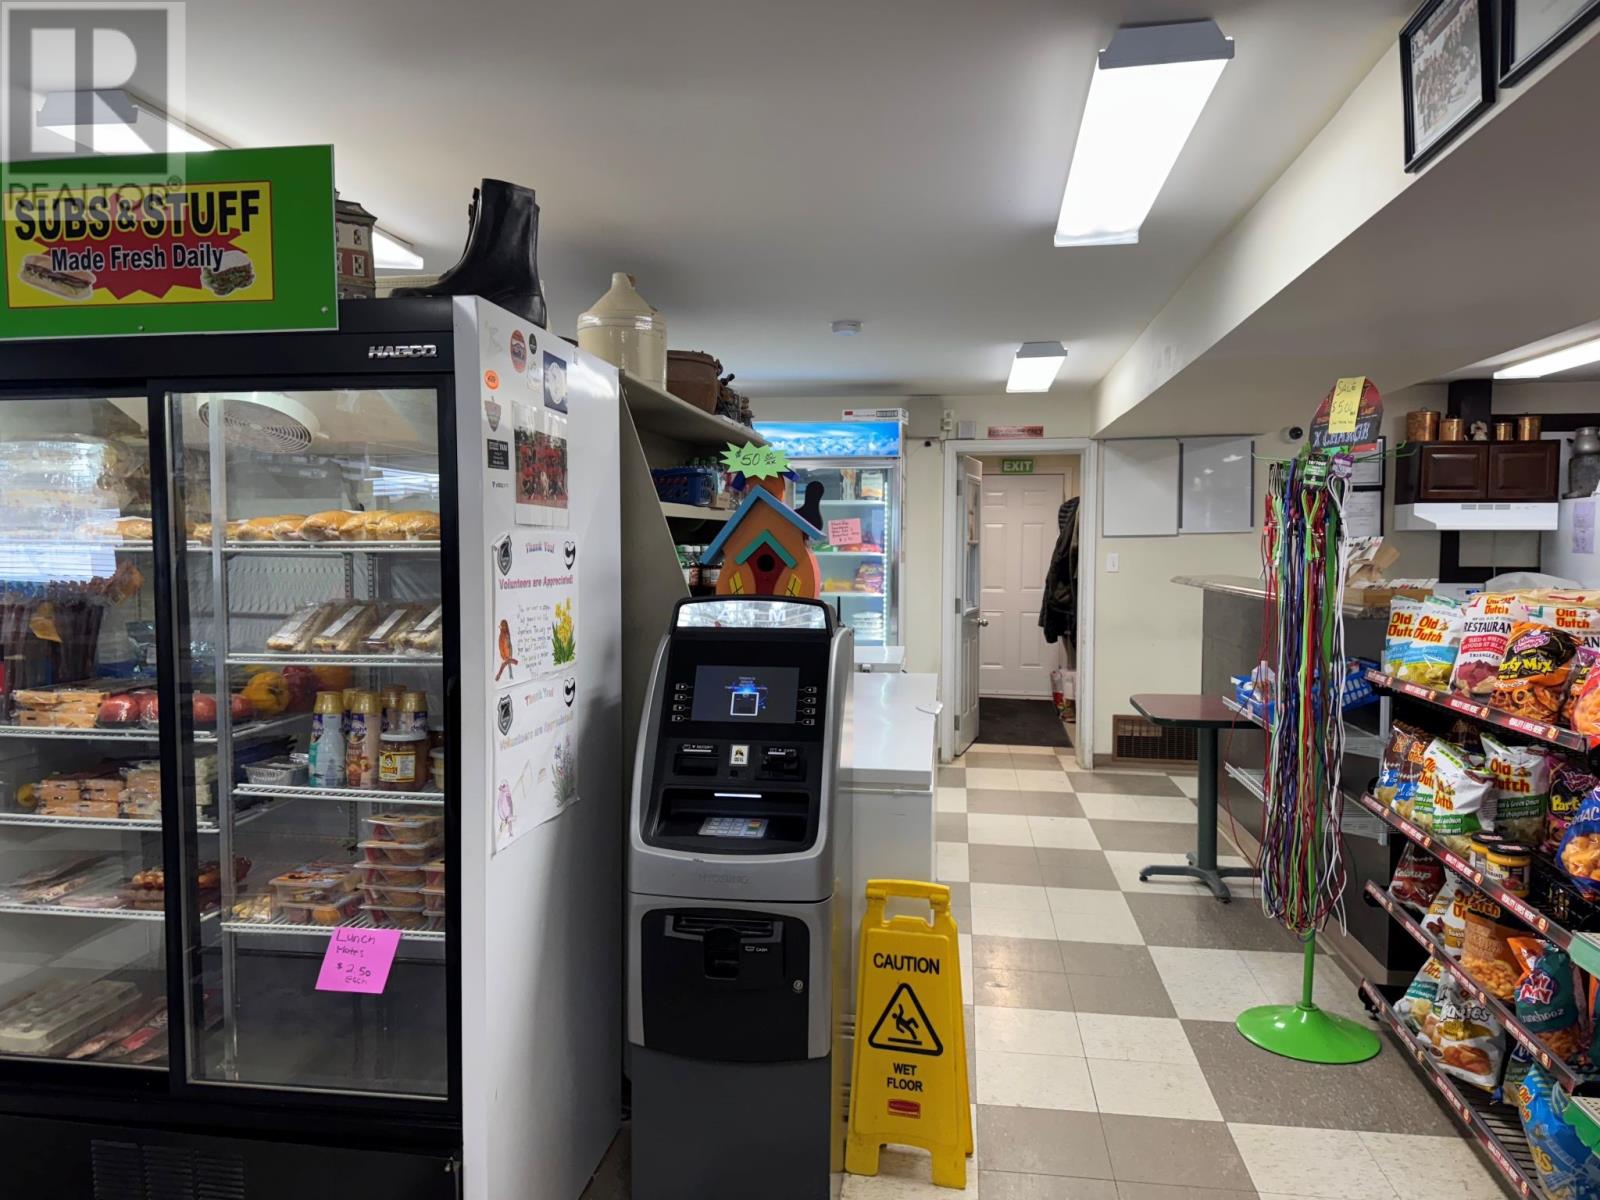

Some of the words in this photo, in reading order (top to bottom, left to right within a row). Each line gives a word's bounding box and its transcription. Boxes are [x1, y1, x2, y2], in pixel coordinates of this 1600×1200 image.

[14, 196, 112, 241] SUBS
[117, 198, 137, 231] &
[143, 190, 260, 237] STUFF
[52, 246, 104, 272] Made
[110, 245, 165, 270] Fresh
[172, 243, 224, 270] Daily
[1003, 460, 1033, 472] EXIT
[499, 577, 532, 590] Volunteers
[532, 578, 542, 588] are
[1391, 611, 1413, 625] Old
[1556, 608, 1577, 618] Old
[1419, 615, 1439, 629] Old
[1556, 617, 1590, 629] Dutch
[1413, 627, 1442, 643] Dutch
[1491, 758, 1511, 775] Old
[336, 929, 376, 945] Lunch
[873, 953, 940, 975] CAUTION
[893, 1062, 918, 1076] WET
[887, 1076, 924, 1093] FLOOR
